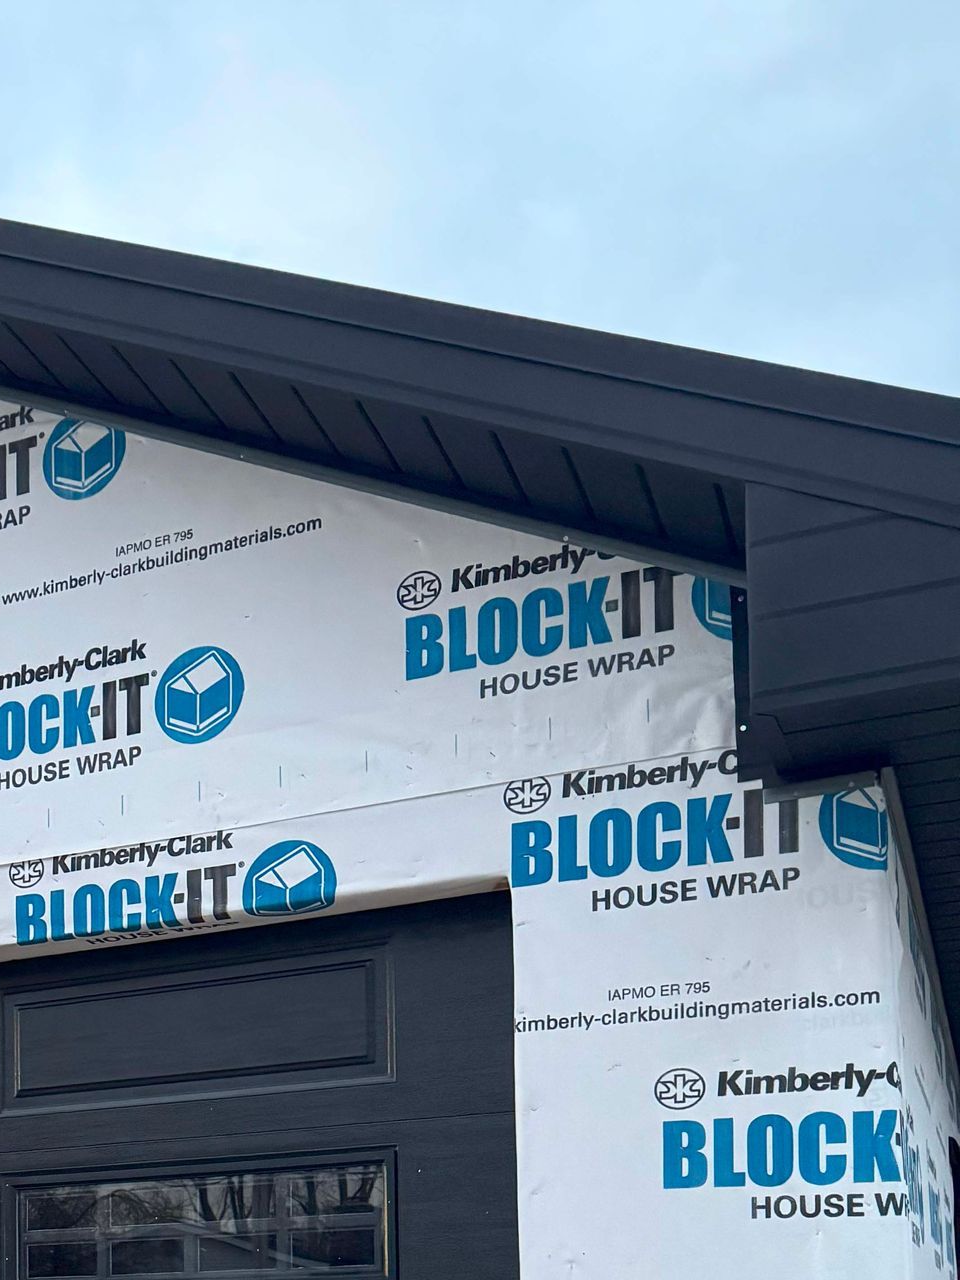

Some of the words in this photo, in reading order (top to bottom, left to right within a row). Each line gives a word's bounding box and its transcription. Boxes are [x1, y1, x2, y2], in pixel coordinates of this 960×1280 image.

[1, 516, 322, 606] www.kimberly-clarkbuildingmaterials.com
[115, 539, 152, 557] IAPMO
[154, 534, 171, 547] ER
[173, 528, 194, 543] 795
[479, 661, 579, 699] HOUSE
[589, 643, 676, 678] WRAP
[76, 745, 143, 776] WRAP
[53, 830, 234, 875] Kimberly-Clark
[591, 878, 697, 912] HOUSE
[706, 867, 801, 898] WRAP
[608, 984, 656, 1002] IAPMO
[660, 982, 681, 997] ER
[685, 981, 711, 996] 795
[751, 1194, 865, 1220] HOUSE
